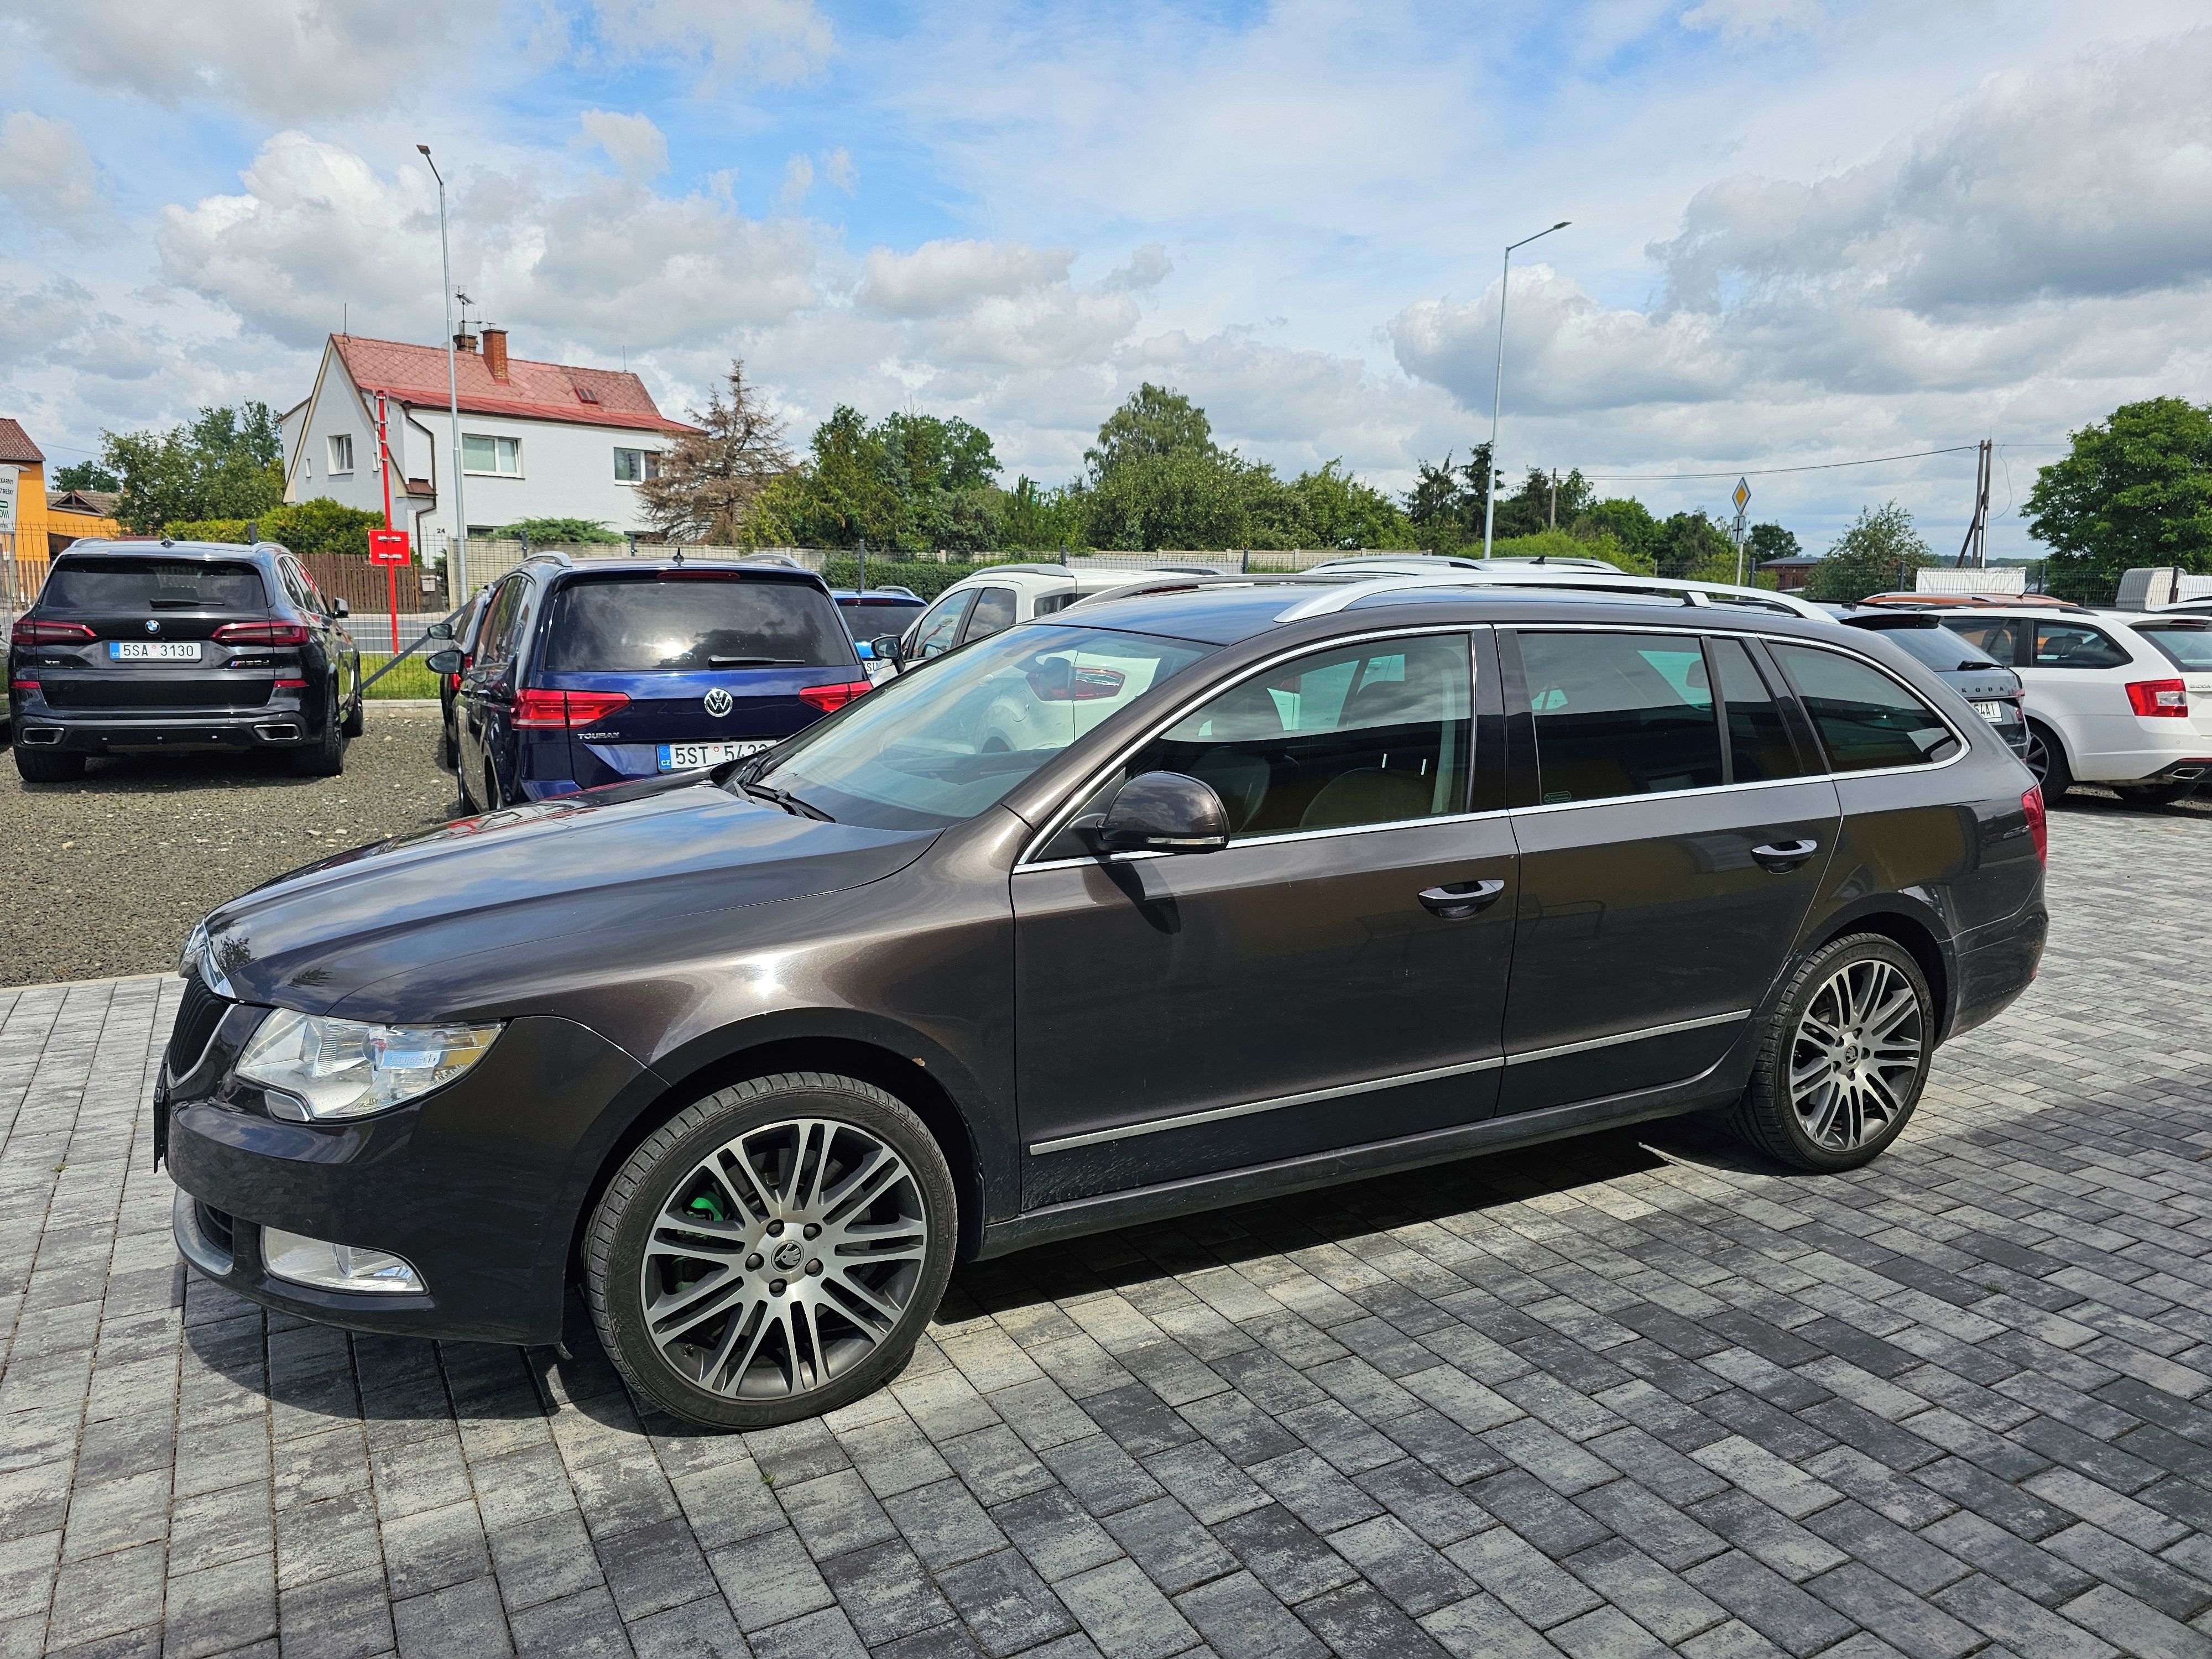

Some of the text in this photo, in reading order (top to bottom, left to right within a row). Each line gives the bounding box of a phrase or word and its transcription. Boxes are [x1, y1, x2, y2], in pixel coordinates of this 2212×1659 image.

[0, 487, 14, 495] TŘEŠKY
[123, 645, 194, 656] 5SA 3130
[675, 743, 768, 765] 5ST 543
[390, 1052, 437, 1066] Superb
